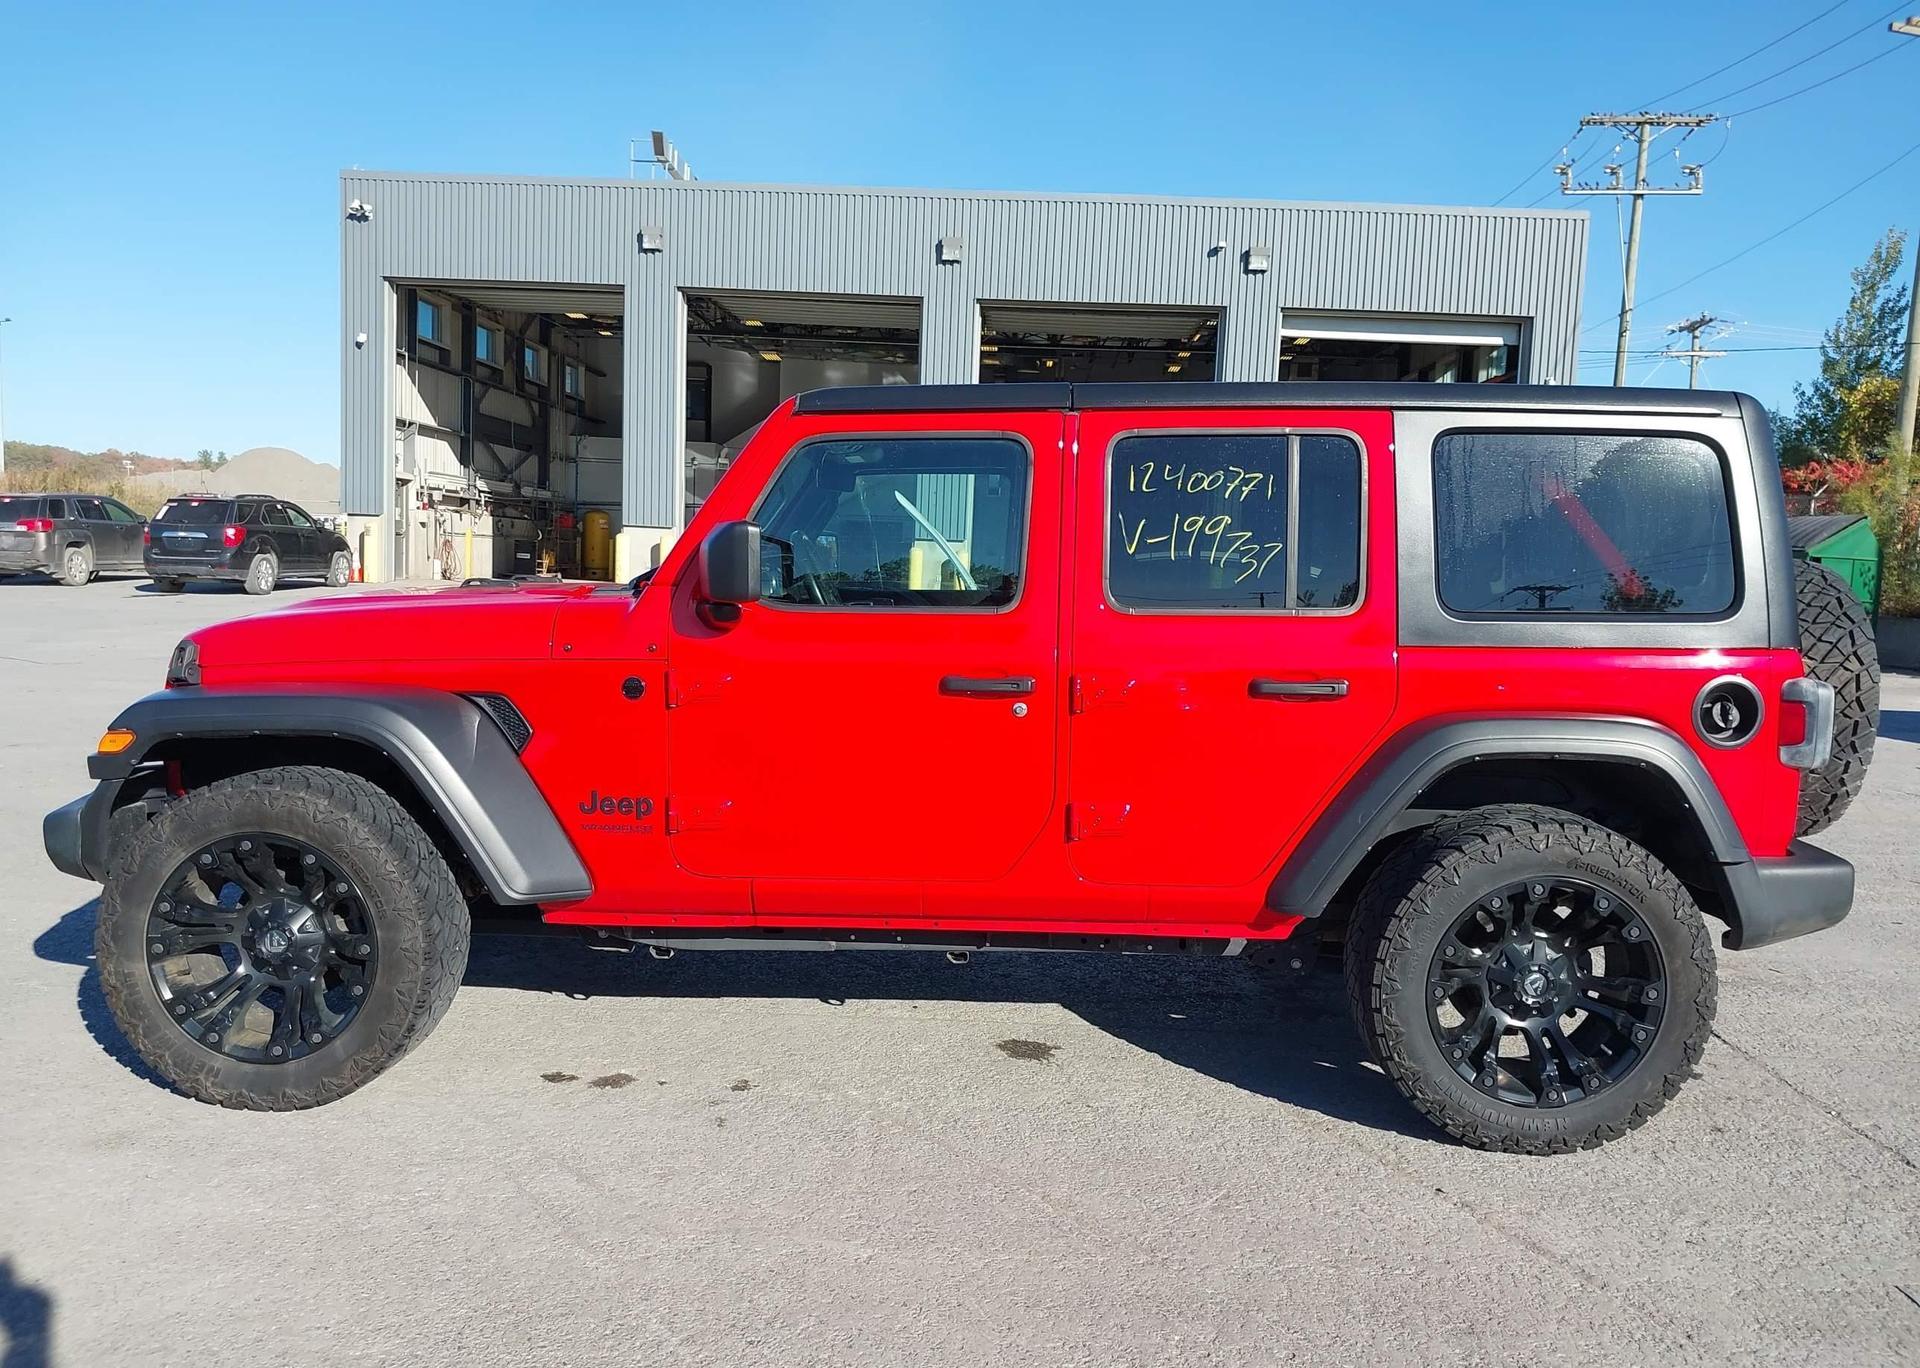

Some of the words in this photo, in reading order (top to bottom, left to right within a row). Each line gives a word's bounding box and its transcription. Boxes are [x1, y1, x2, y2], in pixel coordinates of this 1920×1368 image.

[1129, 461, 1275, 502] 12400771
[1118, 511, 1283, 584] V-199737
[579, 790, 654, 820] Jeep
[1574, 861, 1649, 904] PREDATOR
